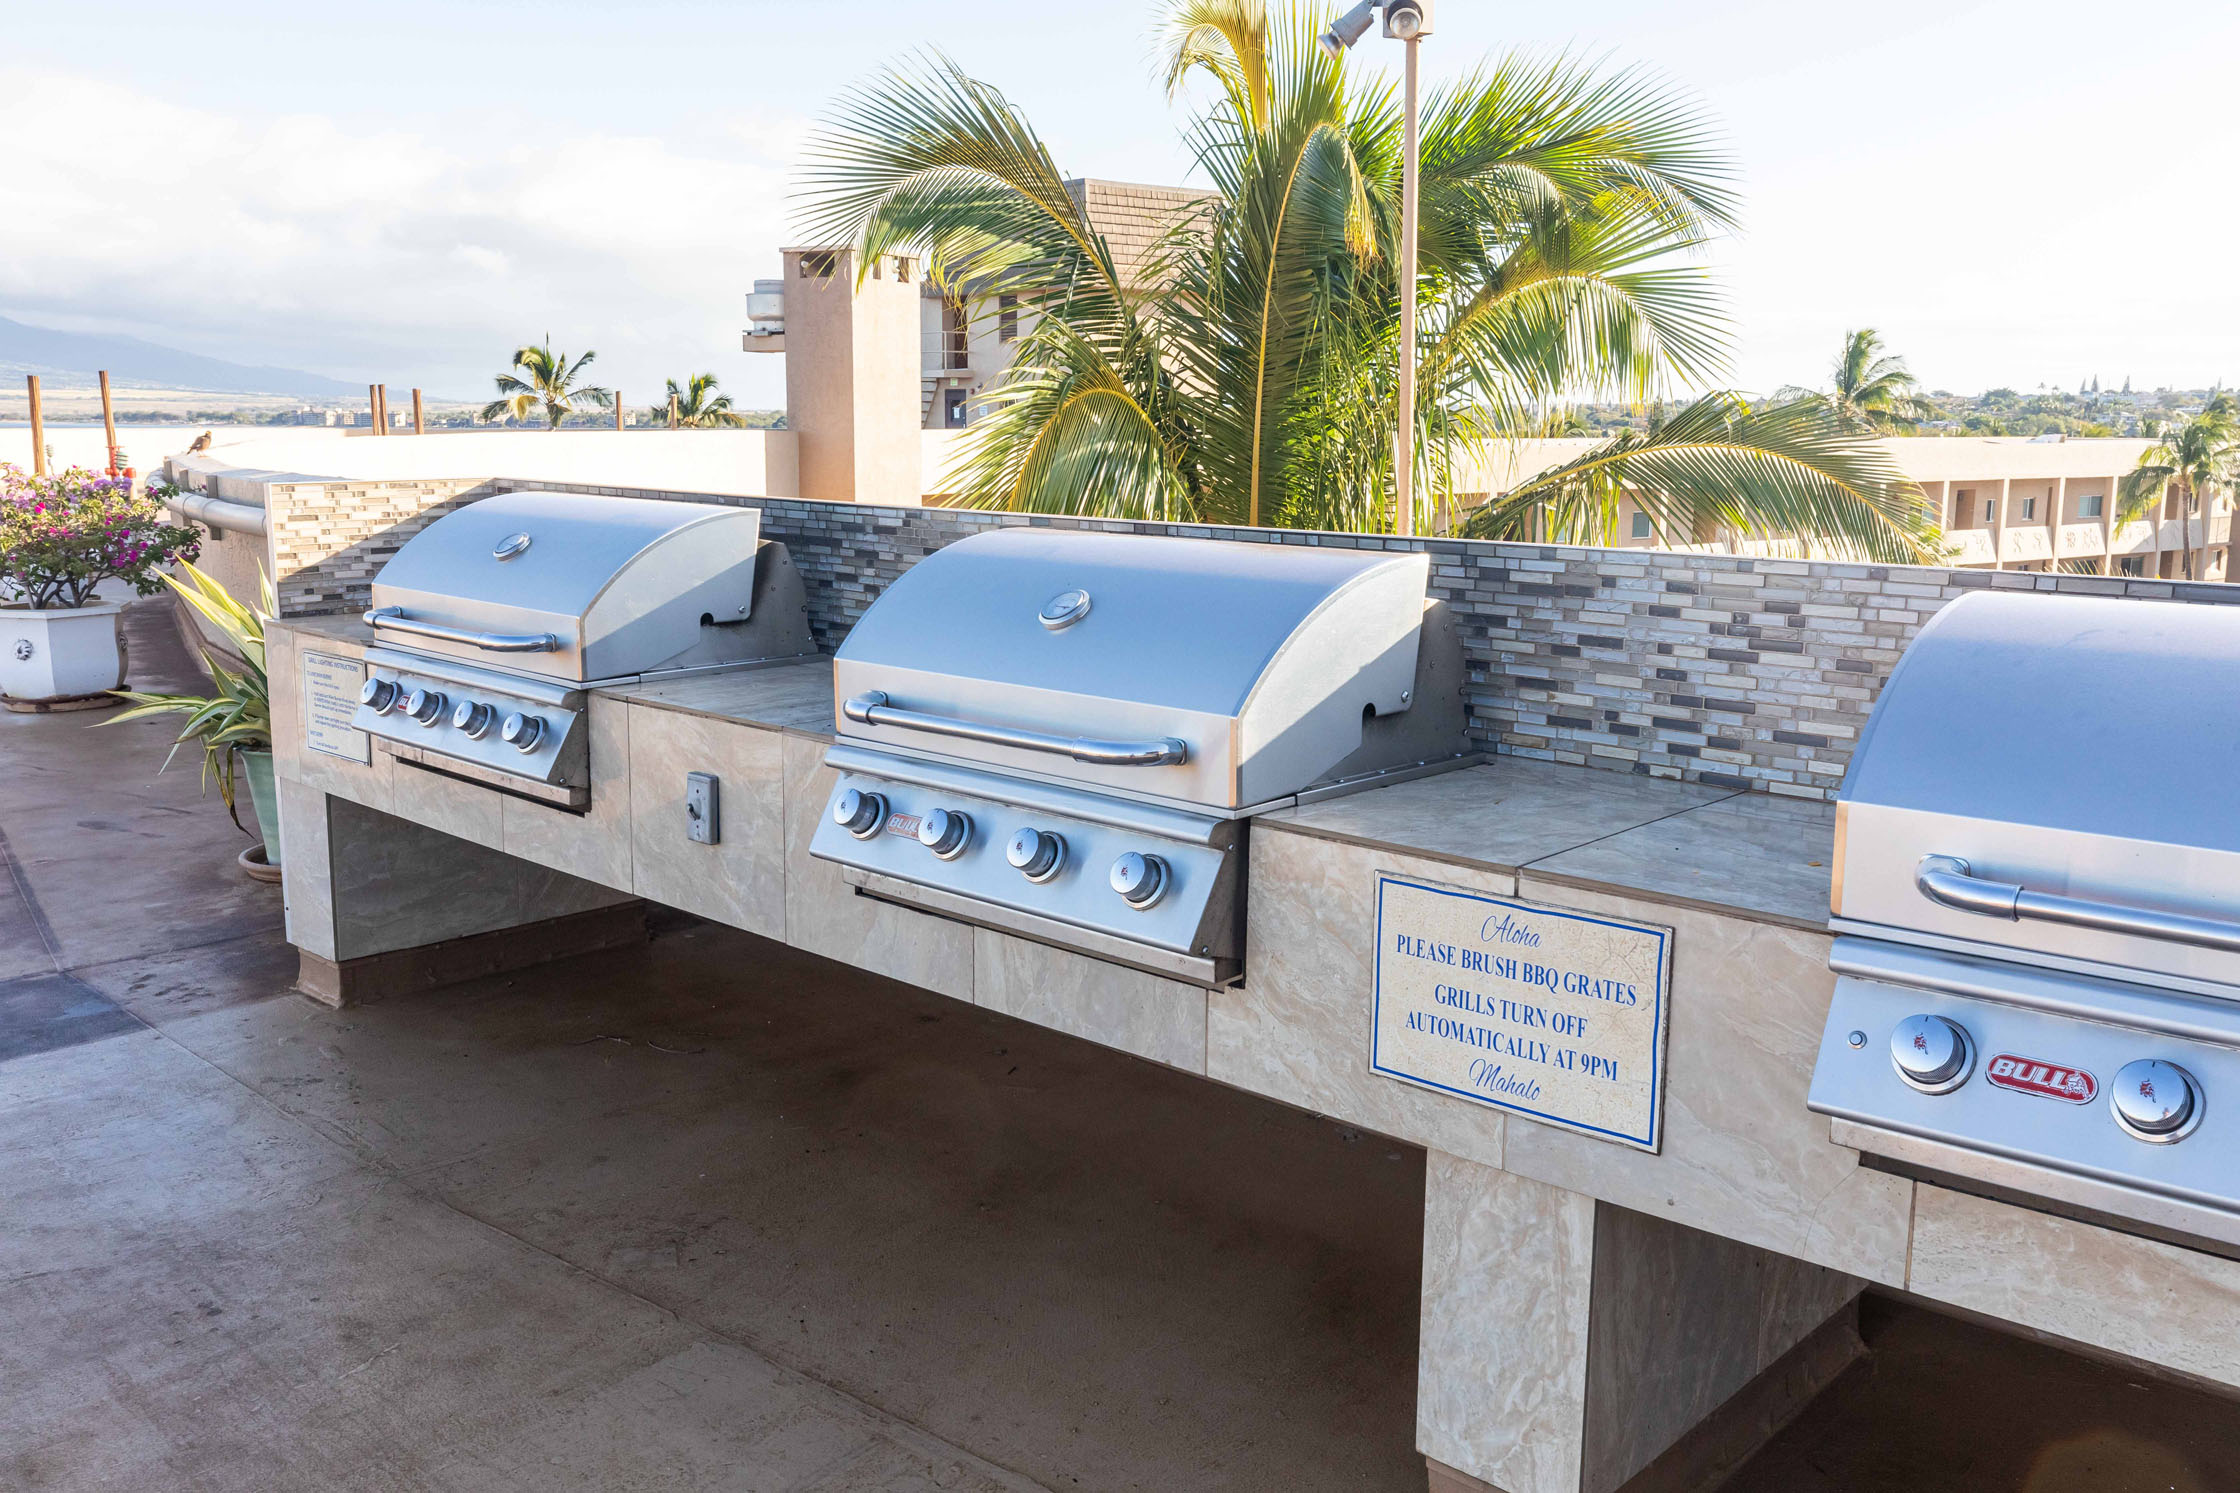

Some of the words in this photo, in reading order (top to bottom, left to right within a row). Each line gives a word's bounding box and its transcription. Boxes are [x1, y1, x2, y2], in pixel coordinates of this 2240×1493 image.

[1480, 913, 1541, 949] Aloha
[1396, 932, 1457, 967] PLEASE
[1461, 947, 1518, 982] BRUSH
[1522, 961, 1560, 996] BBQ
[1563, 970, 1638, 1009] GRATES
[1433, 983, 1497, 1017] GRILLS
[1499, 999, 1549, 1030] TURN
[1551, 1011, 1589, 1040] OFF
[1404, 1010, 1550, 1065] AUTOMATICALLY
[1553, 1047, 1579, 1073] AT
[1580, 1052, 1619, 1083] 9PM
[1467, 1057, 1542, 1103] Mahalo
[1990, 1058, 2066, 1090] BULL
